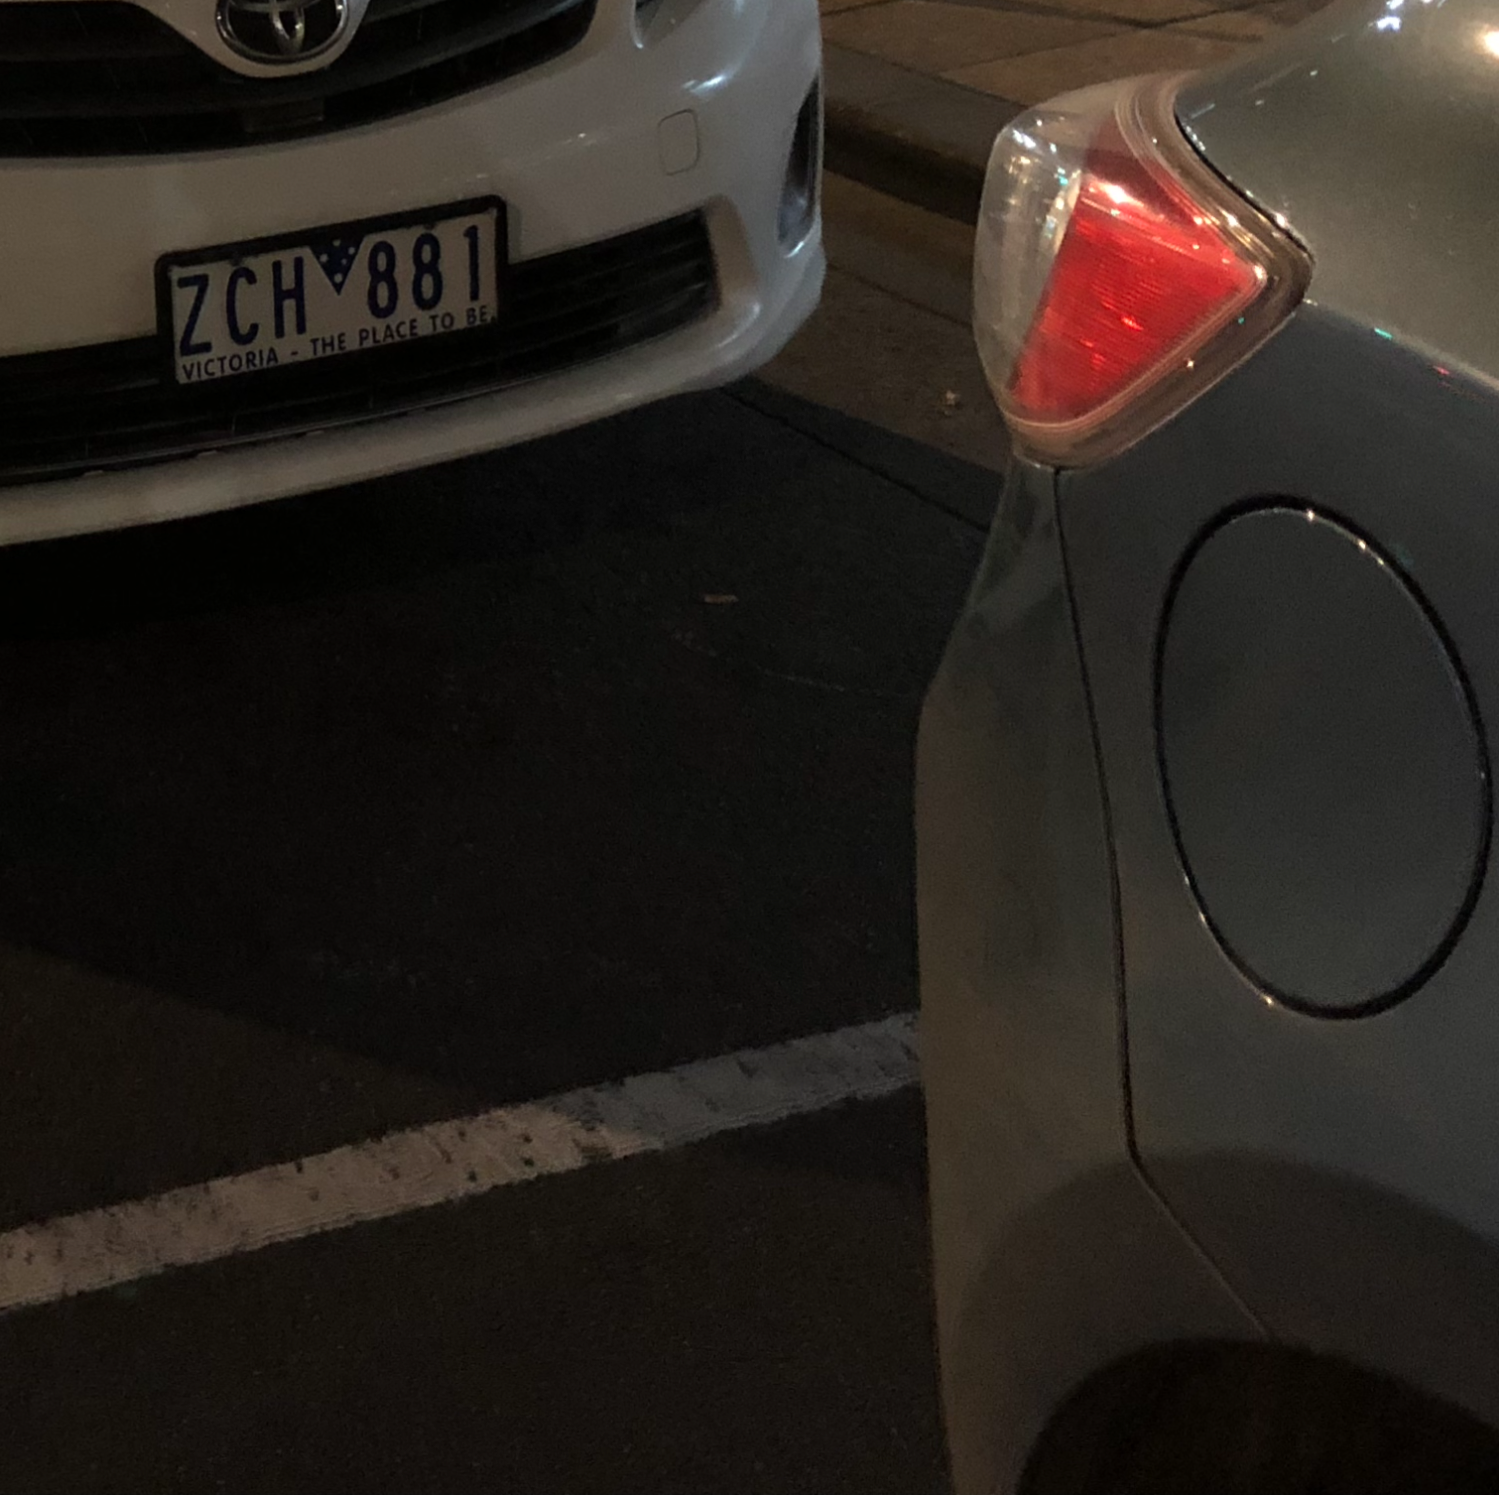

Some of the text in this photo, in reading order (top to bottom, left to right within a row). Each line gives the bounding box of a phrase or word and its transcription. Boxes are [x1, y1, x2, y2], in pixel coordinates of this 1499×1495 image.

[177, 224, 480, 356] ZCH 881
[182, 347, 279, 380] VICTORIA
[310, 332, 347, 356] THE
[359, 318, 419, 347] PLACE
[429, 312, 455, 332] TO
[466, 305, 488, 326] BE
